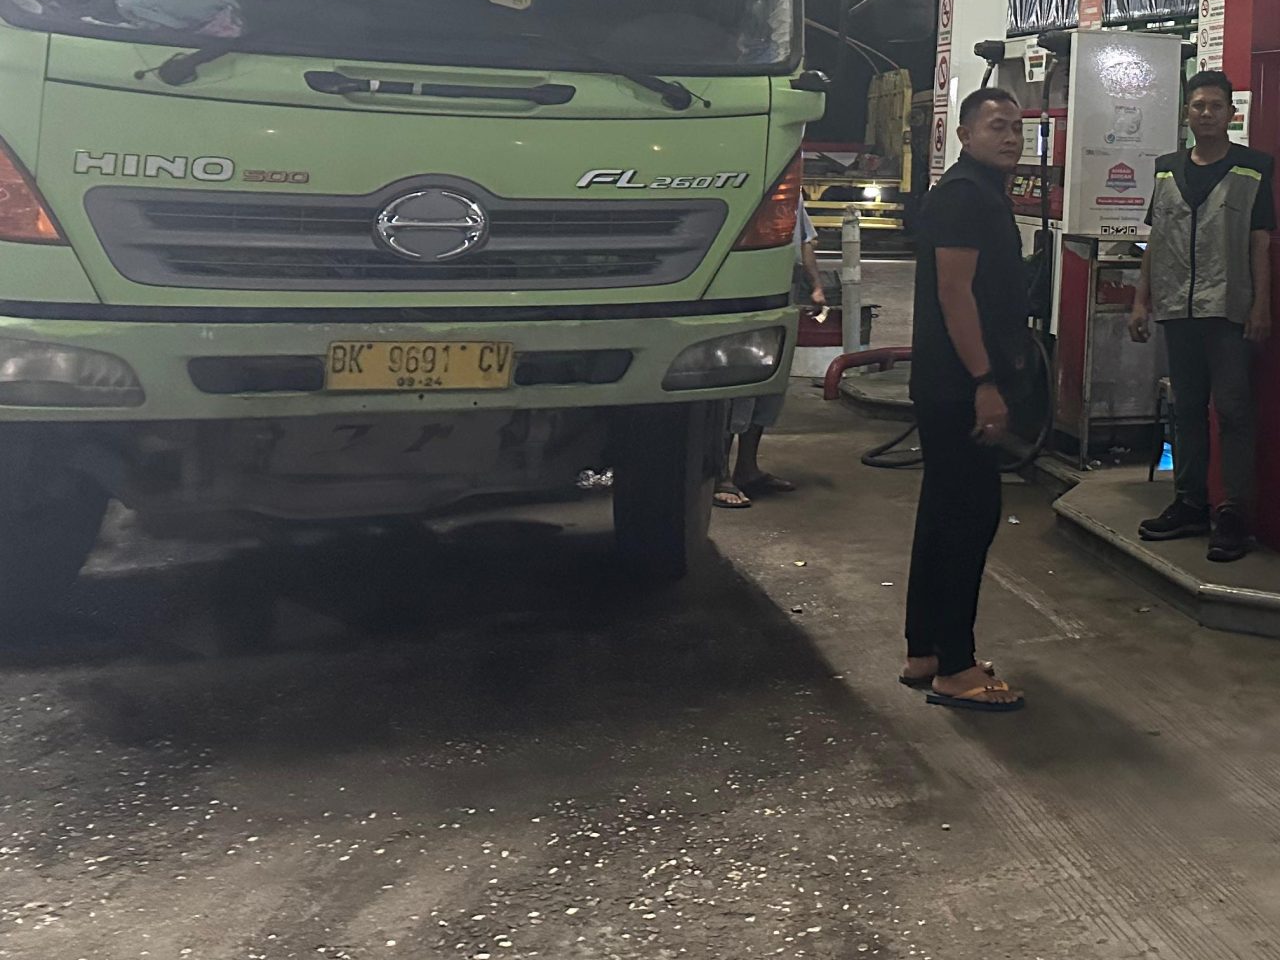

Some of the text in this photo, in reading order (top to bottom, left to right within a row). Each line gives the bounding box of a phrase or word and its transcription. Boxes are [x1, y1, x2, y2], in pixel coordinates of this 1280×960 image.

[73, 150, 310, 184] HINO 500
[332, 345, 511, 374] BK 9691 CV
